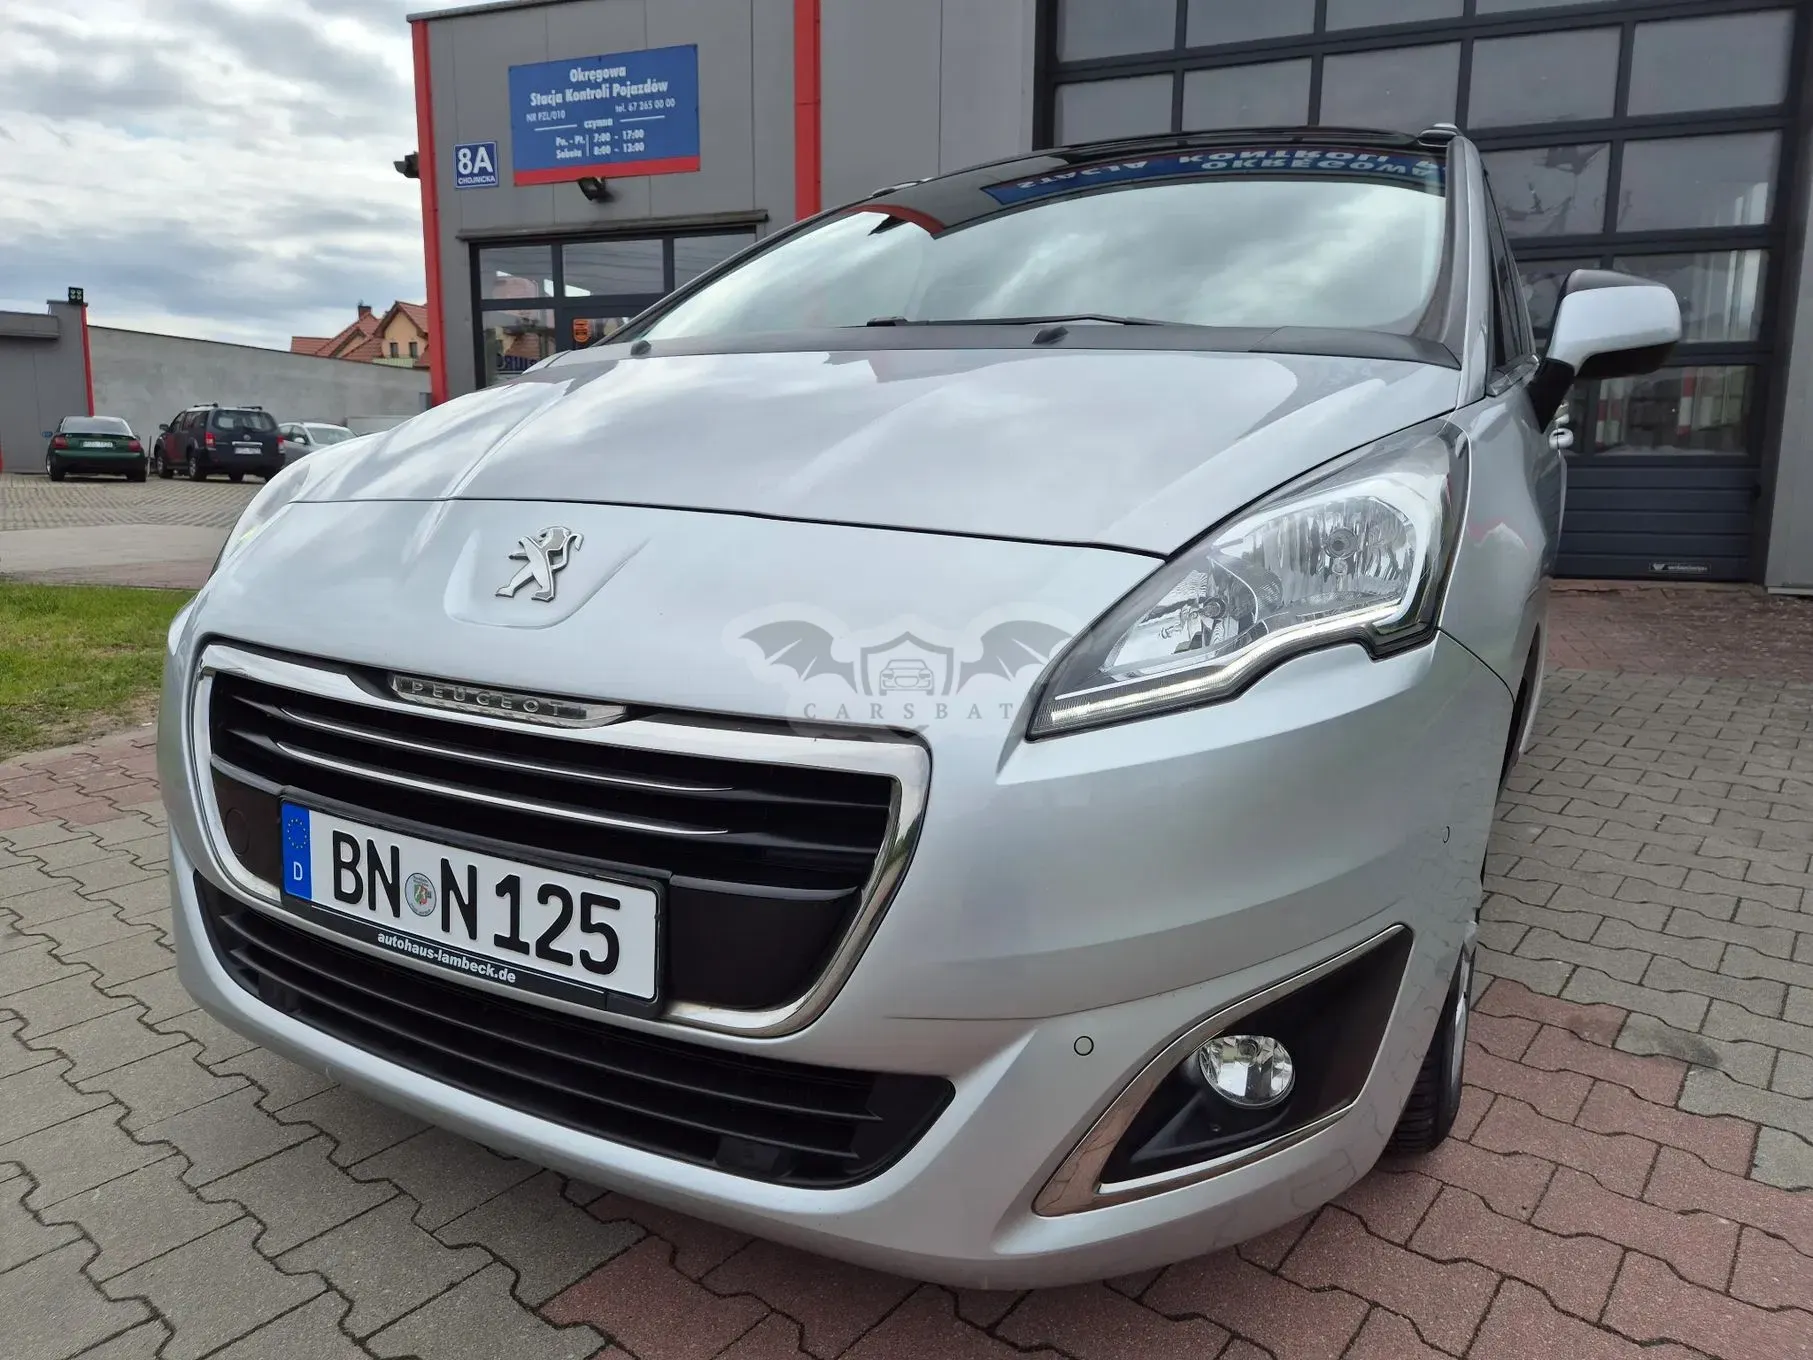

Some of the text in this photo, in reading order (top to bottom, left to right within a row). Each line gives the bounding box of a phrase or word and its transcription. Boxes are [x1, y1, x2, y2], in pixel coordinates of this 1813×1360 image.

[569, 66, 626, 83] Okręgowa
[530, 78, 668, 106] Stacja Kontroli Pojazdów
[615, 103, 627, 112] tel.
[628, 101, 637, 112] 67
[639, 100, 653, 110] 265
[593, 132, 611, 142] 7:00
[622, 129, 645, 140] 17:00
[458, 146, 494, 175] 8A
[458, 176, 496, 184] CHOJNICKA
[411, 680, 564, 717] PEUGEOT
[293, 861, 303, 881] D
[332, 829, 401, 918] BN
[377, 931, 517, 984] autohaus-lambeck.de
